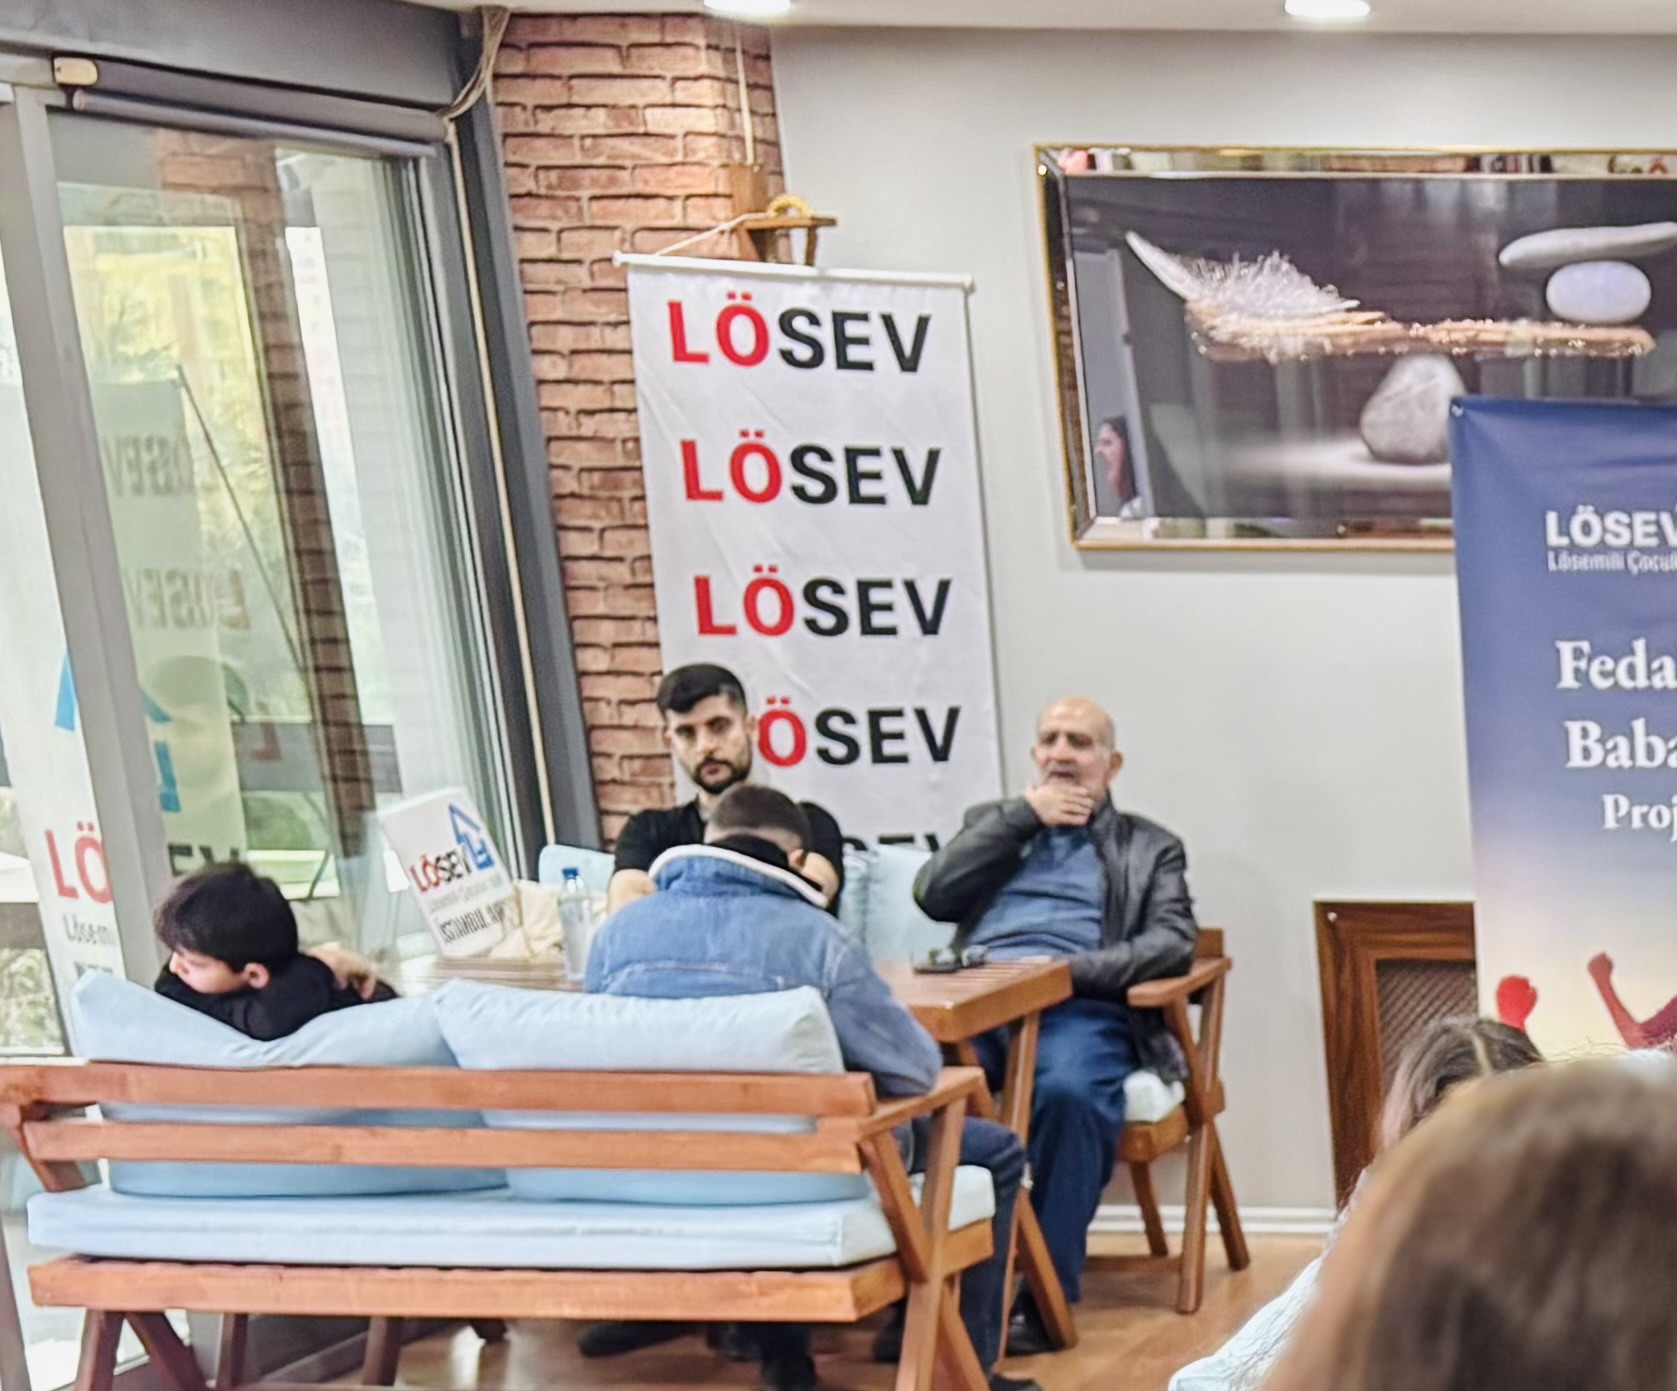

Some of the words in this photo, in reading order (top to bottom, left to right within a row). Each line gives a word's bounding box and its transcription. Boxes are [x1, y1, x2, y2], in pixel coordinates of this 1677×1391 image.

[667, 291, 931, 373] LÖSEV
[680, 430, 941, 506] LÖSEV
[694, 565, 951, 638] LÖSEV
[757, 697, 960, 769] ÖSEV
